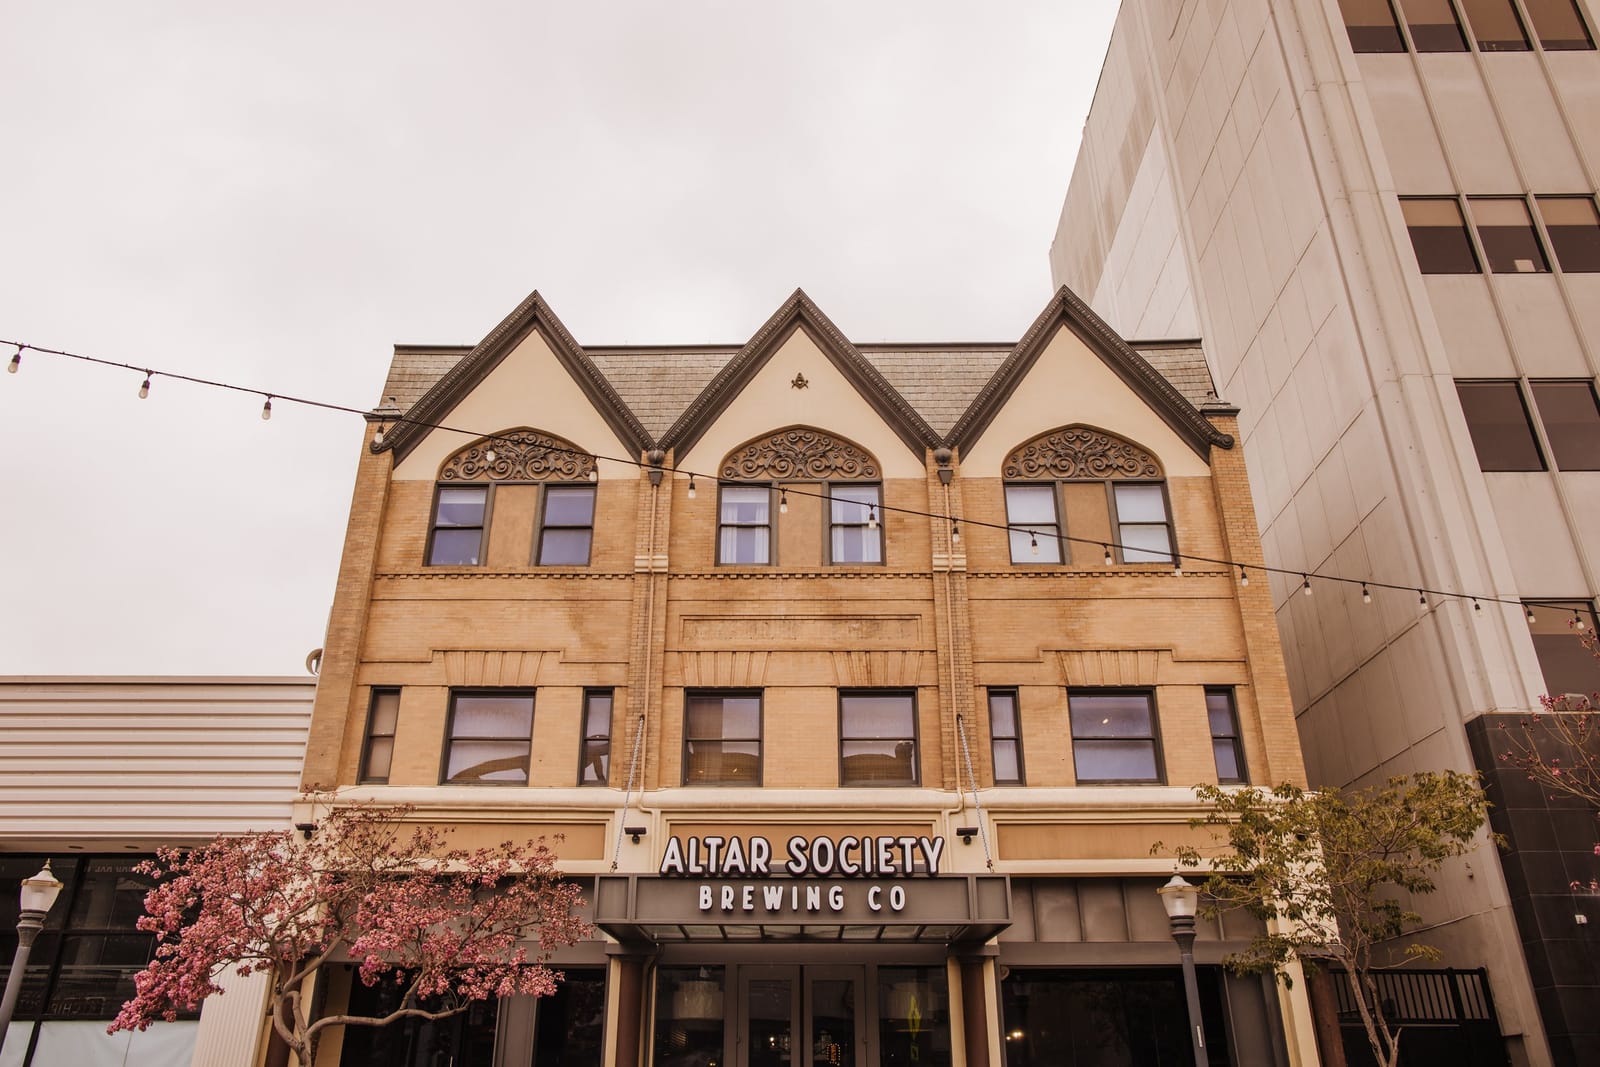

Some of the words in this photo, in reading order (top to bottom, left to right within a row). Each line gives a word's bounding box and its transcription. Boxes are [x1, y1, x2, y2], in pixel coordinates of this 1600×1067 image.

[661, 837, 770, 873] ALTAR
[788, 837, 943, 873] SOCIETY
[699, 885, 844, 911] BREWING
[867, 885, 906, 911] CO
